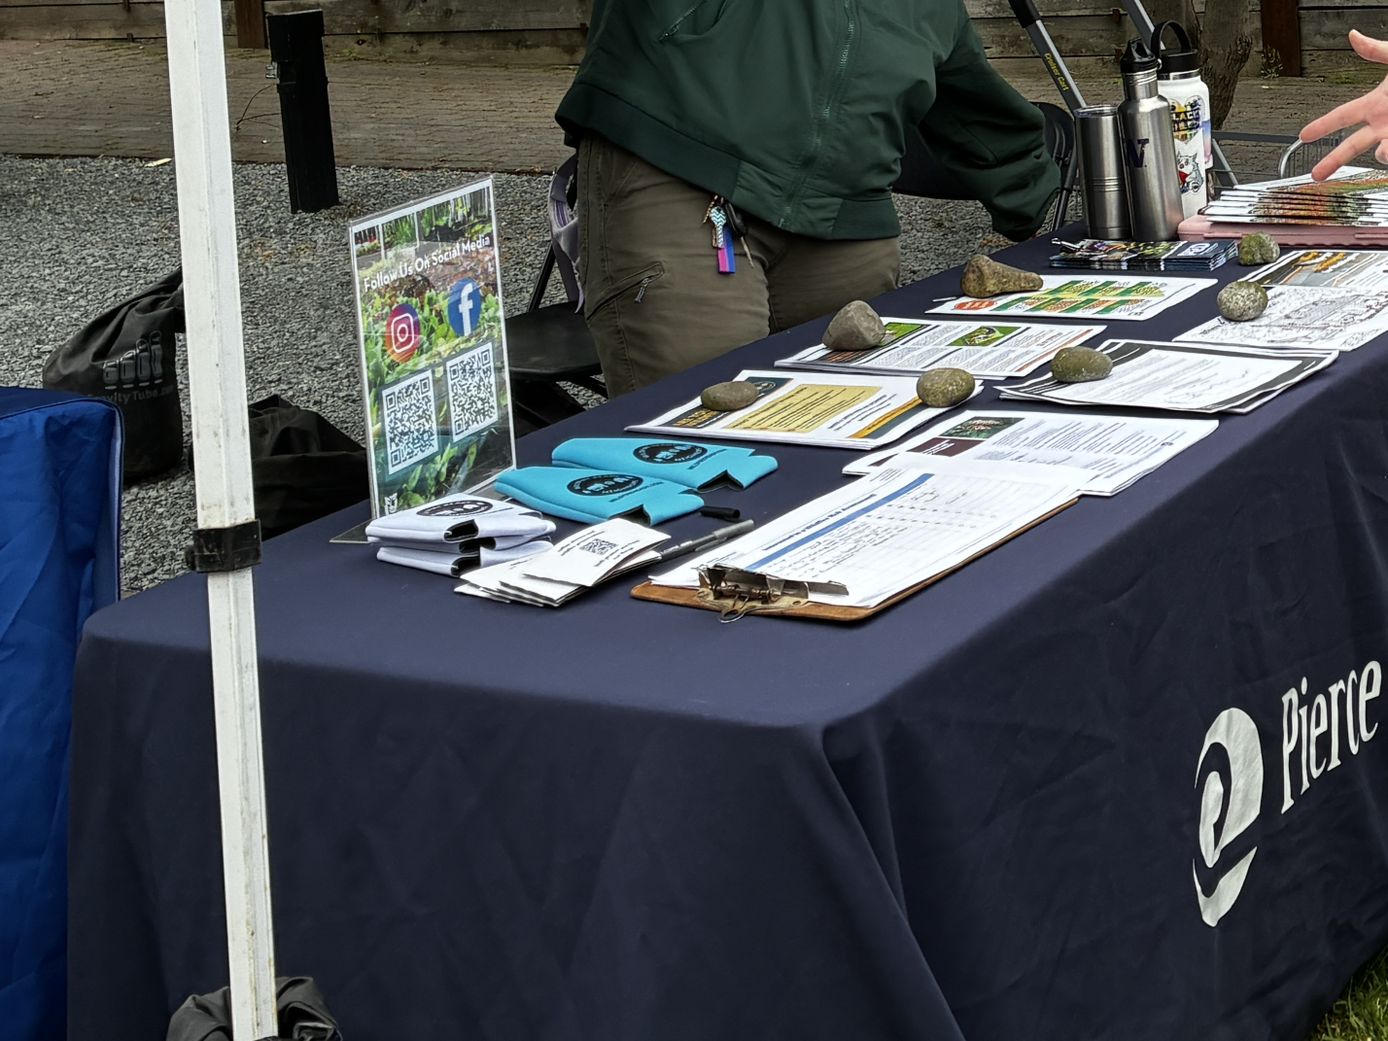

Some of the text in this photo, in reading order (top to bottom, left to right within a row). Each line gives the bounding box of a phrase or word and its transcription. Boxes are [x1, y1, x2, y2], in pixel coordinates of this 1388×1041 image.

[363, 234, 490, 292] Follow Us On Social Media
[1281, 660, 1382, 815] Pierce
